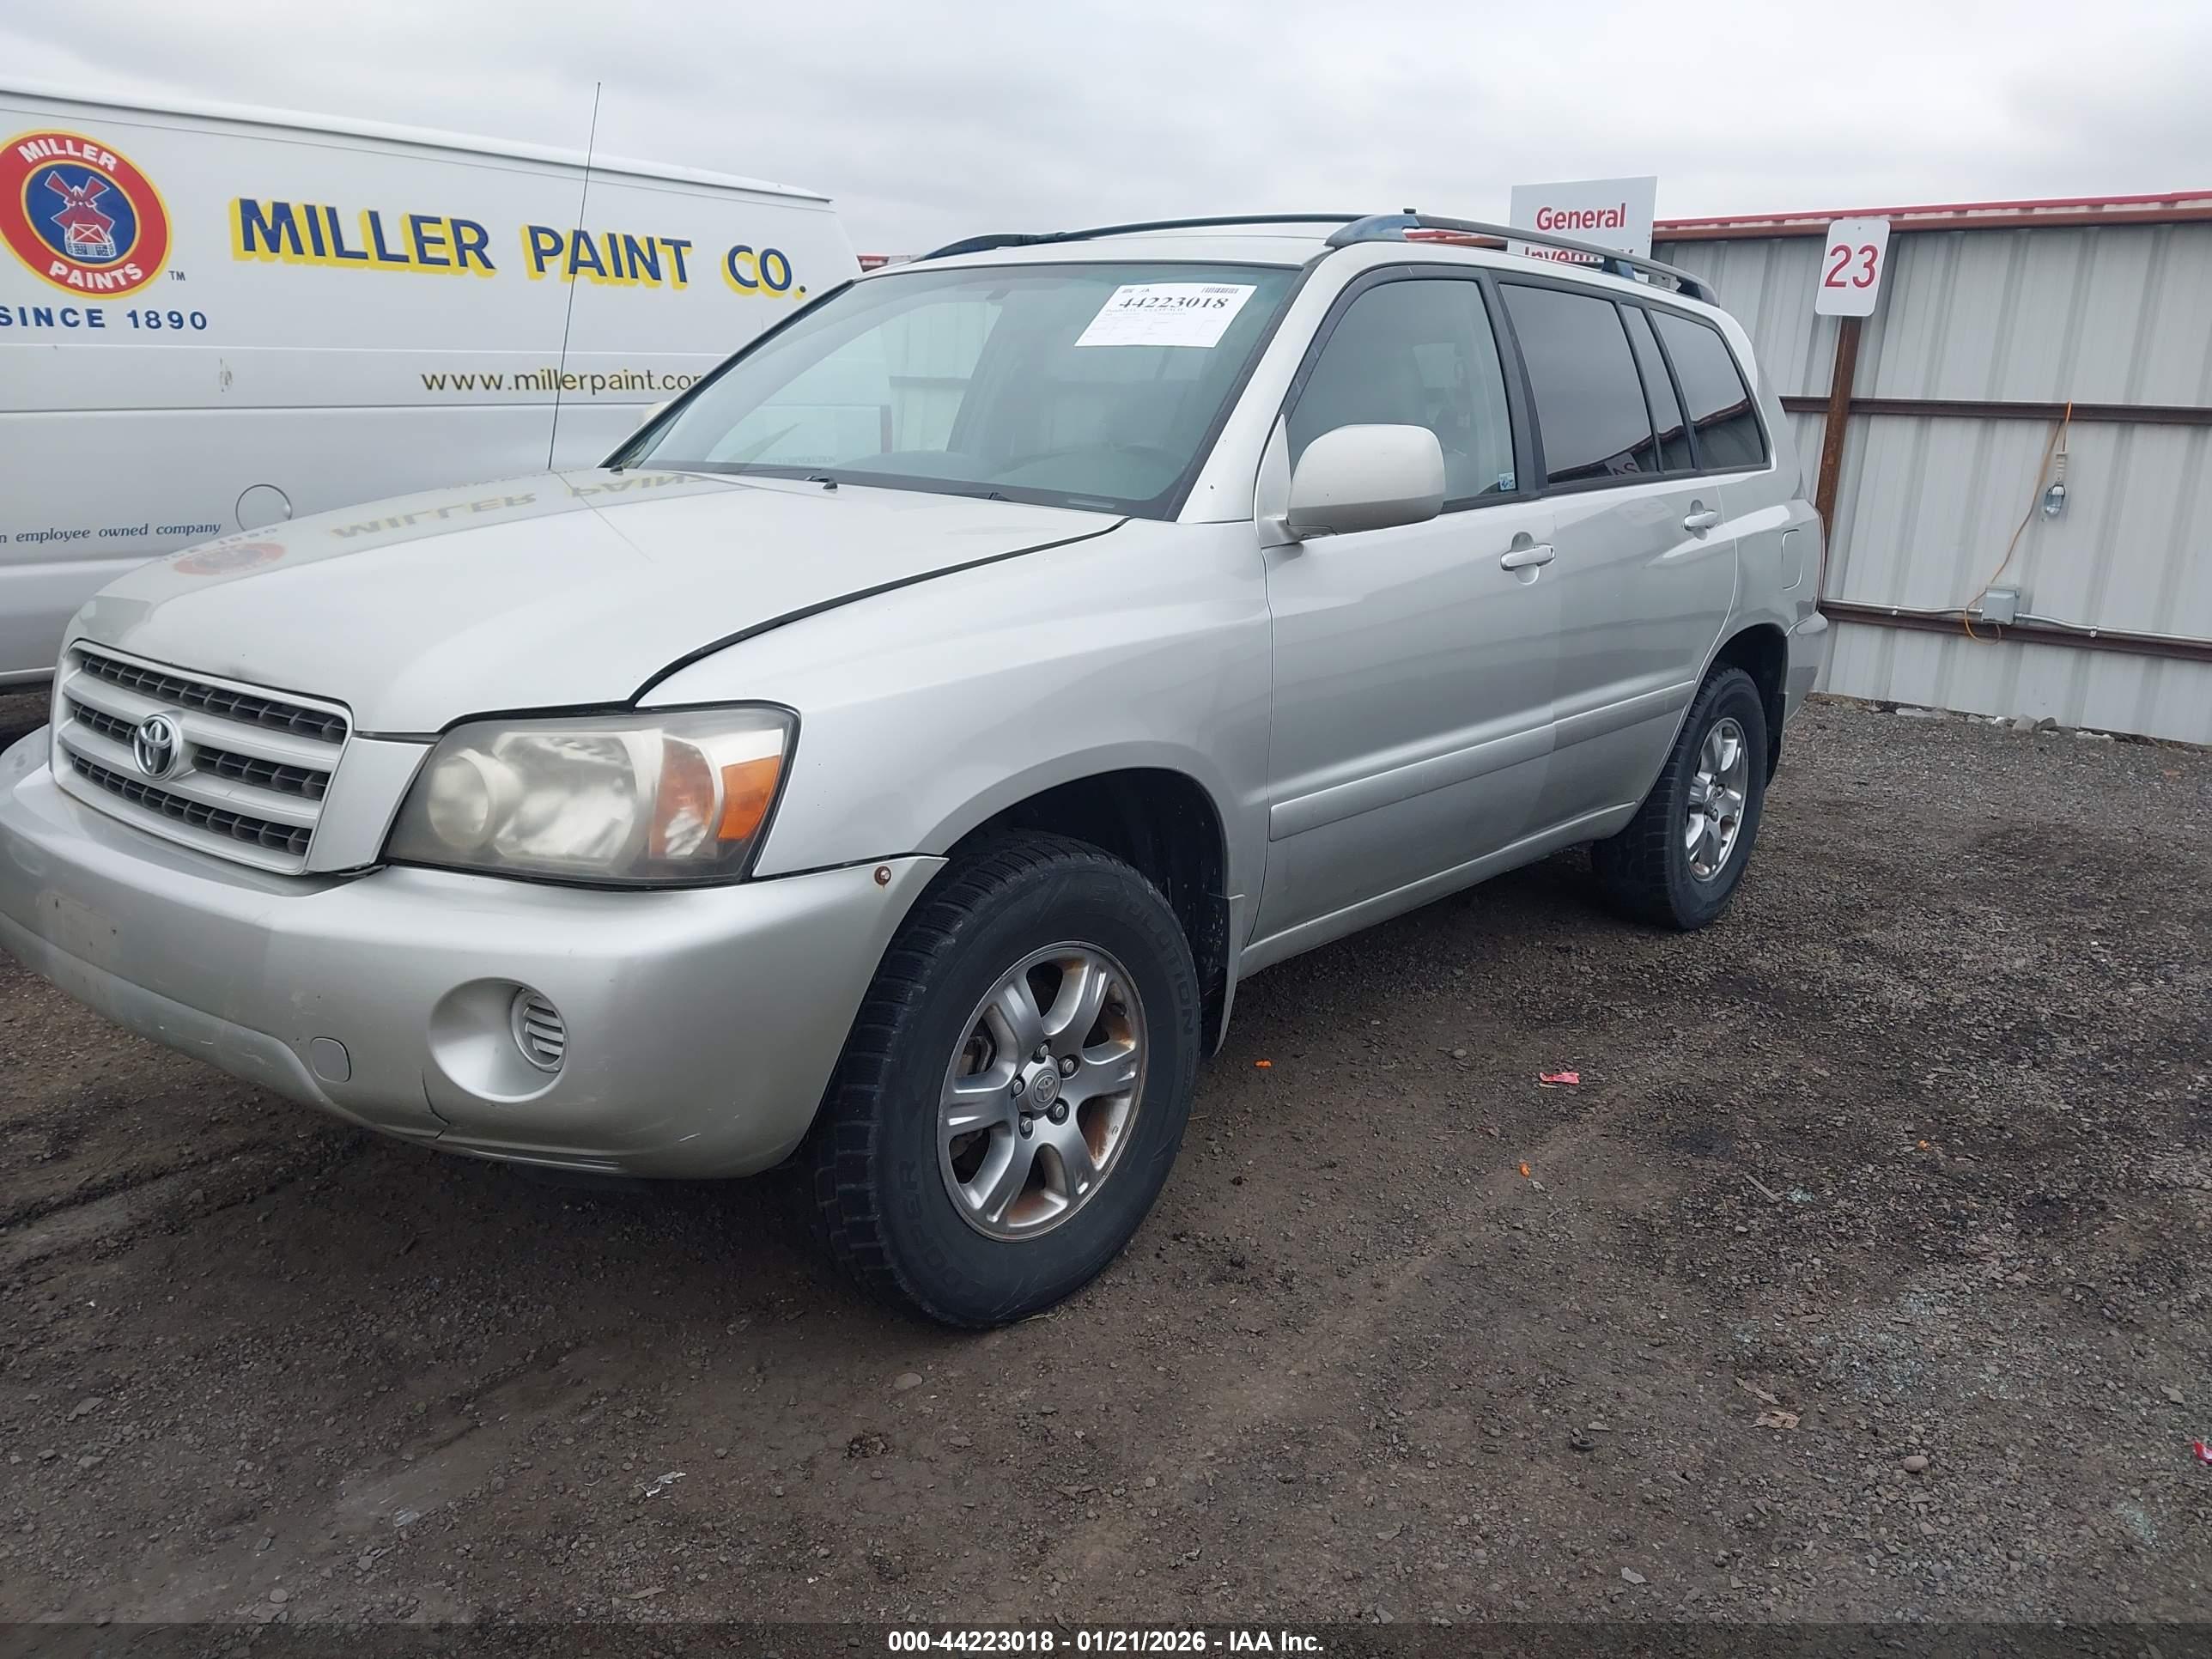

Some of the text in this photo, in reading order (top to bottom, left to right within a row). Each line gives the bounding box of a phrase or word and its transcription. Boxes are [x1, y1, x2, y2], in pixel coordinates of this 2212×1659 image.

[17, 137, 117, 172] MILLER
[1536, 202, 1626, 231] General
[233, 198, 806, 296] MILLER PAINT CO.
[49, 260, 143, 289] PAINTS
[1825, 243, 1879, 289] 23
[1119, 296, 1229, 309] 44223018
[0, 305, 208, 330] SINCE 1890
[15, 527, 90, 544] employee
[98, 523, 149, 538] owned
[155, 522, 222, 536] company
